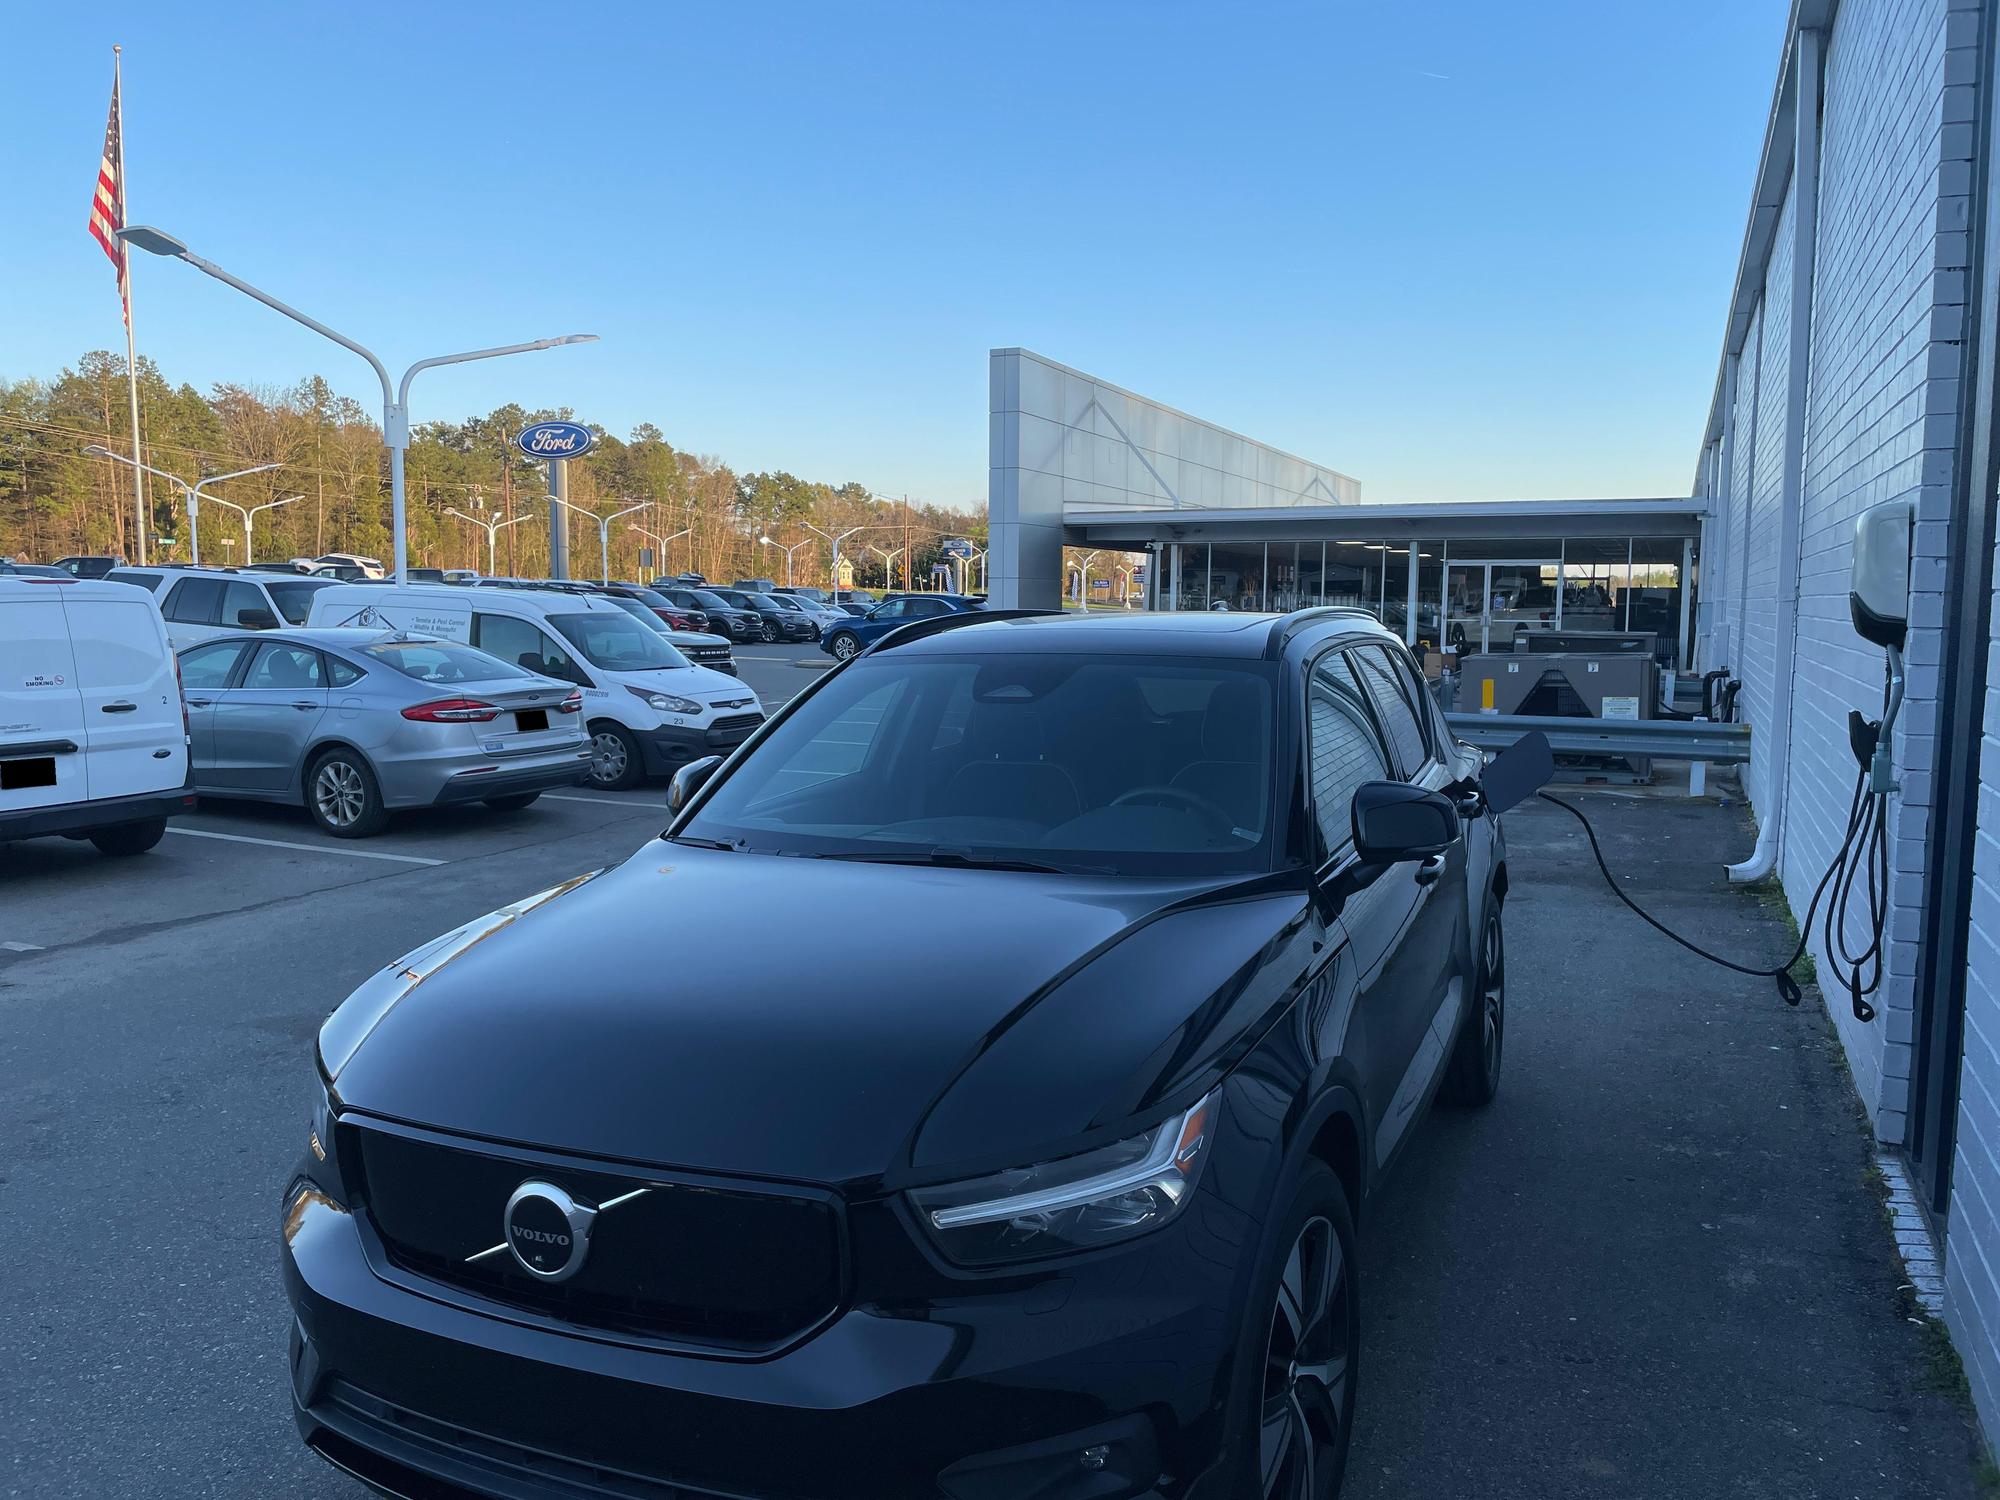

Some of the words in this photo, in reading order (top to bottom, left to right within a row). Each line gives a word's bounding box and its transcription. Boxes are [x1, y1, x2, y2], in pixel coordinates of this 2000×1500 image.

[531, 428, 575, 451] Ford
[161, 695, 167, 705] 2
[673, 717, 684, 725] 23
[511, 1225, 570, 1246] VOLVO
